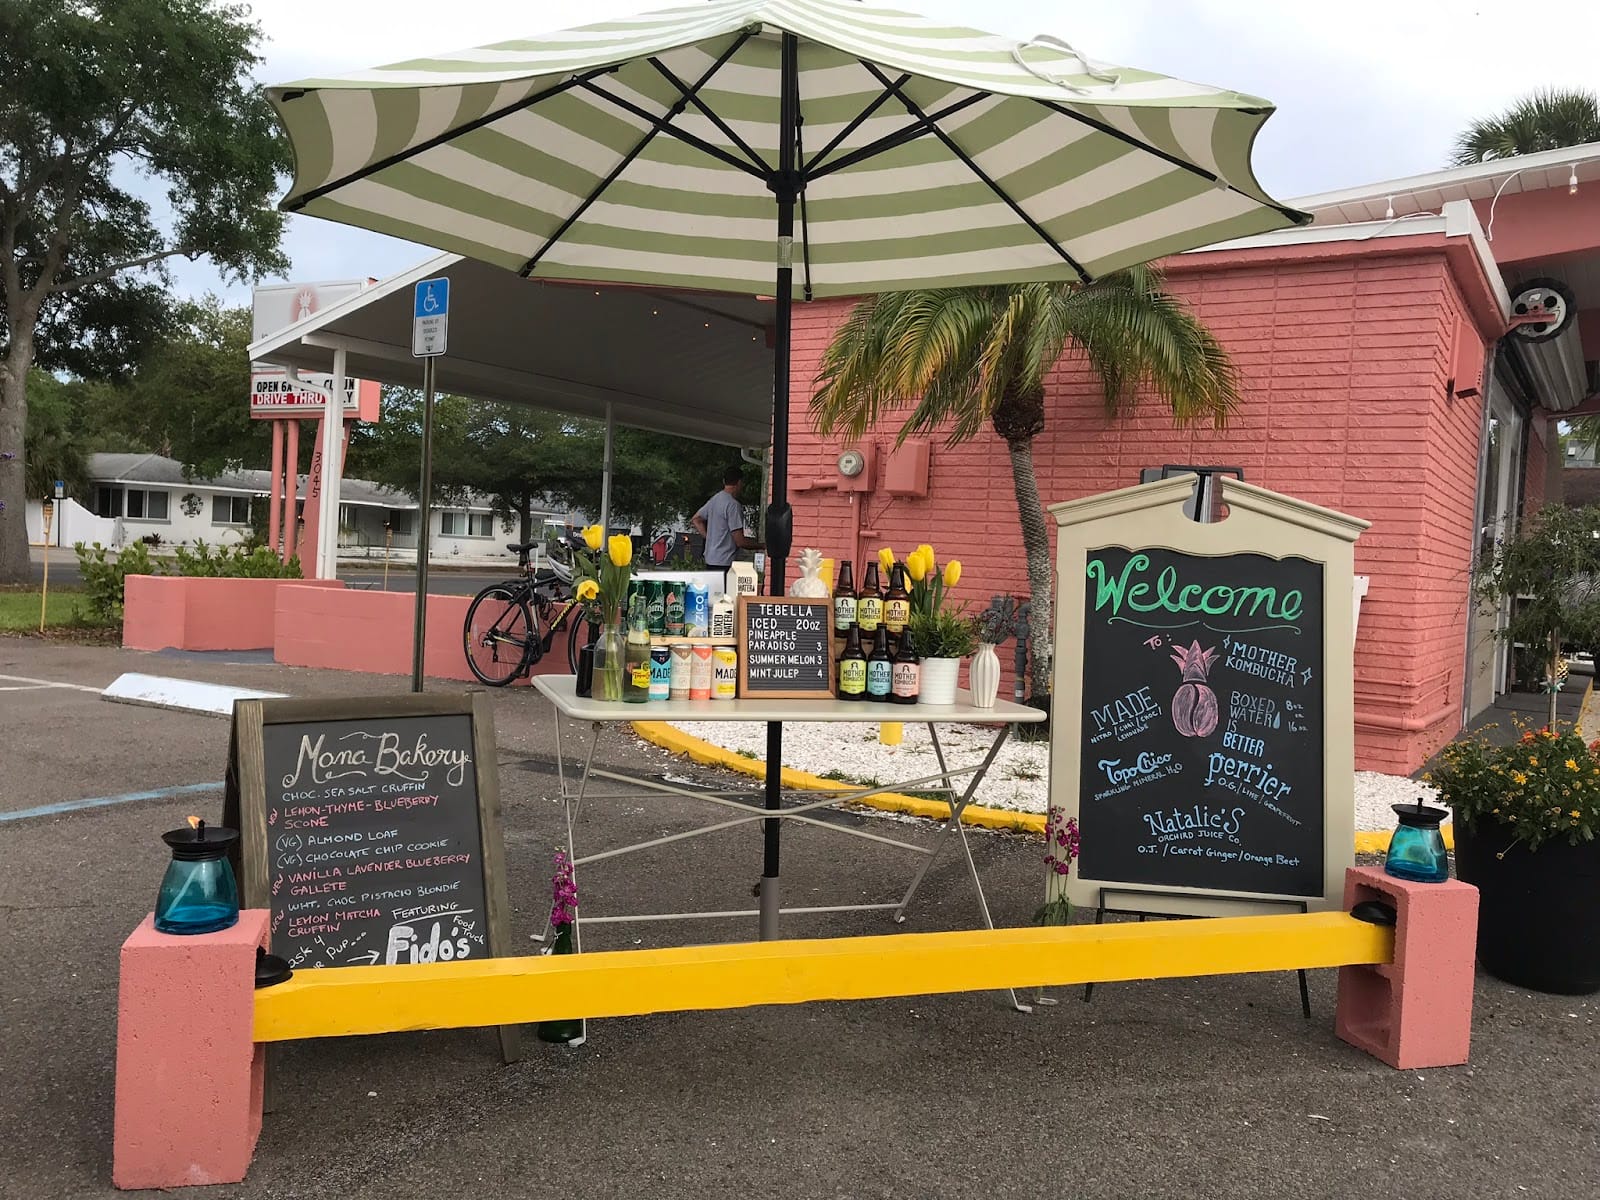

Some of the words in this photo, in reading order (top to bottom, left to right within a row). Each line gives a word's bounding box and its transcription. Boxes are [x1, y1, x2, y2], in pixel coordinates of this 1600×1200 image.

[256, 381, 279, 393] OPEN
[256, 393, 288, 405] DRIVE
[293, 391, 323, 405] THRU
[312, 451, 322, 498] 3045
[737, 576, 753, 585] BOXED
[737, 584, 753, 593] WATER
[1087, 554, 1303, 621] Welcome
[695, 595, 704, 623] ZICO
[759, 604, 813, 616] TEBELLA
[713, 614, 723, 636] BOXED
[724, 614, 733, 636] WATER
[751, 618, 777, 629] ICED
[748, 630, 797, 640] PINEAPPLE
[748, 641, 796, 651] PARADISO
[816, 642, 822, 652] 3
[749, 655, 786, 665] SUMMER
[788, 655, 815, 665] MELON
[817, 655, 823, 665] 3
[1232, 642, 1298, 674] MOTHER
[749, 668, 771, 679] MINT
[773, 668, 800, 679] JULEP
[817, 669, 823, 679] 4
[843, 669, 865, 677] MOTHER
[1225, 656, 1295, 688] KOMBUCHA
[1090, 686, 1158, 731] MADE
[1230, 690, 1276, 714] BOXED
[1226, 718, 1238, 733] IS
[1230, 705, 1272, 728] WATER
[1223, 732, 1265, 757] BETTER
[282, 734, 374, 788] Mona
[374, 732, 472, 787] Bakery
[282, 790, 321, 802] CHOC.
[324, 788, 346, 798] SEA
[348, 785, 377, 796] SALT
[381, 782, 426, 793] CRUFFIN
[275, 833, 303, 851] (VG)
[308, 832, 363, 845] ALMOND
[368, 829, 398, 840] LOAF
[1198, 829, 1224, 840] JUICE
[276, 853, 303, 869] (VG)
[305, 849, 370, 864] CHOCOLATE
[375, 844, 403, 855] CHIP
[407, 839, 449, 851] COOKIE
[1170, 845, 1204, 857] Carrot
[1276, 854, 1301, 866] Beet
[347, 861, 404, 876] LAVENDER
[405, 853, 471, 869] BLUEBERRY
[271, 873, 284, 896] NEW
[291, 881, 347, 897] GALLETE
[288, 900, 320, 911] WHT.
[327, 896, 356, 907] CHOC
[361, 888, 412, 903] PISTACIO
[417, 881, 461, 896] BLONDIE
[289, 912, 330, 927] LEMON
[335, 909, 380, 921] MATCHA
[391, 901, 460, 920] FEATURING
[271, 909, 285, 934] NEW
[288, 921, 341, 937] CRUFFIN
[452, 915, 475, 930] Food
[385, 921, 471, 965] Fido's
[462, 926, 484, 945] Truck
[288, 946, 312, 969] ask
[314, 934, 325, 946] 4
